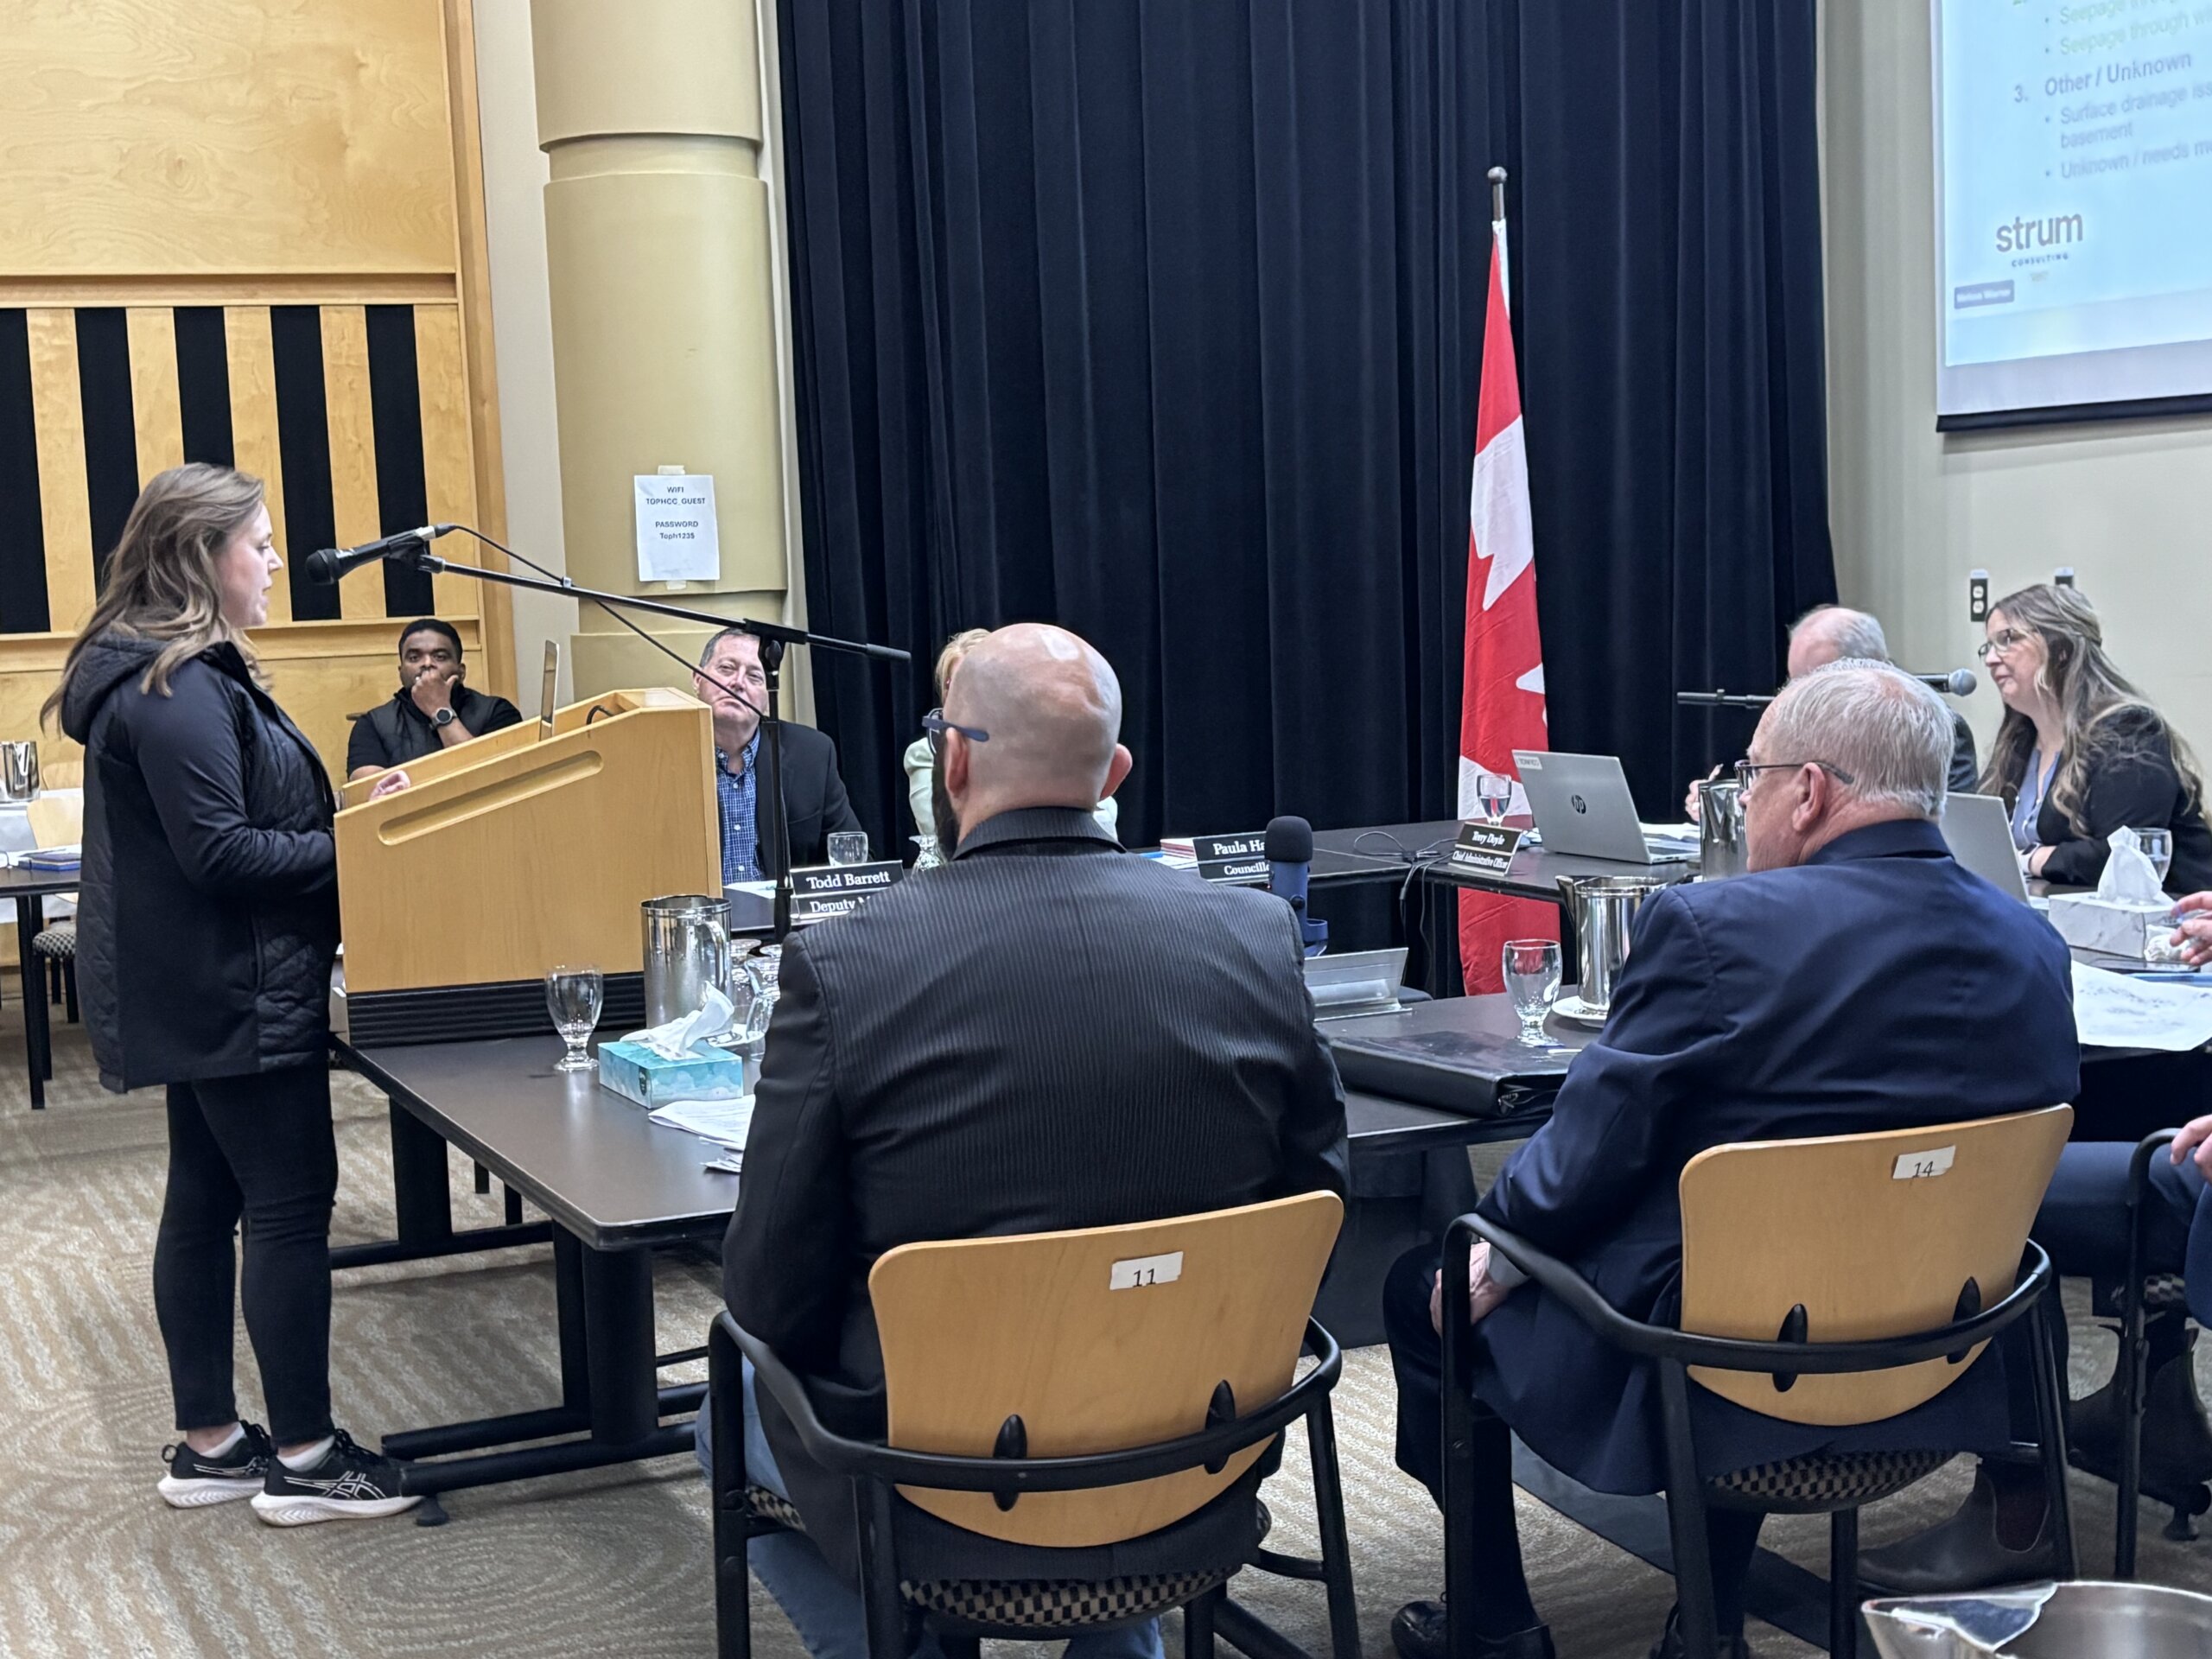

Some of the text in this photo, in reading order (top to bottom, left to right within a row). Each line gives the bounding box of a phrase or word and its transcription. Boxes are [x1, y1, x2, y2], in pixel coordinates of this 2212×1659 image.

[2013, 82, 2031, 103] 3.
[2044, 72, 2093, 97] Other
[2107, 53, 2193, 84] Unknown
[2059, 100, 2118, 125] Surface
[2120, 86, 2189, 113] drainage
[2060, 118, 2134, 149] basement
[2060, 154, 2130, 179] Unknown
[2142, 139, 2190, 165] needs
[1996, 213, 2083, 252] strum
[1572, 794, 1586, 814] hp
[1213, 841, 1248, 855] Paula
[805, 871, 891, 889] Todd Barrett
[810, 899, 855, 913] Deputy
[1912, 1160, 1934, 1178] 14
[1133, 1268, 1156, 1287] 11
